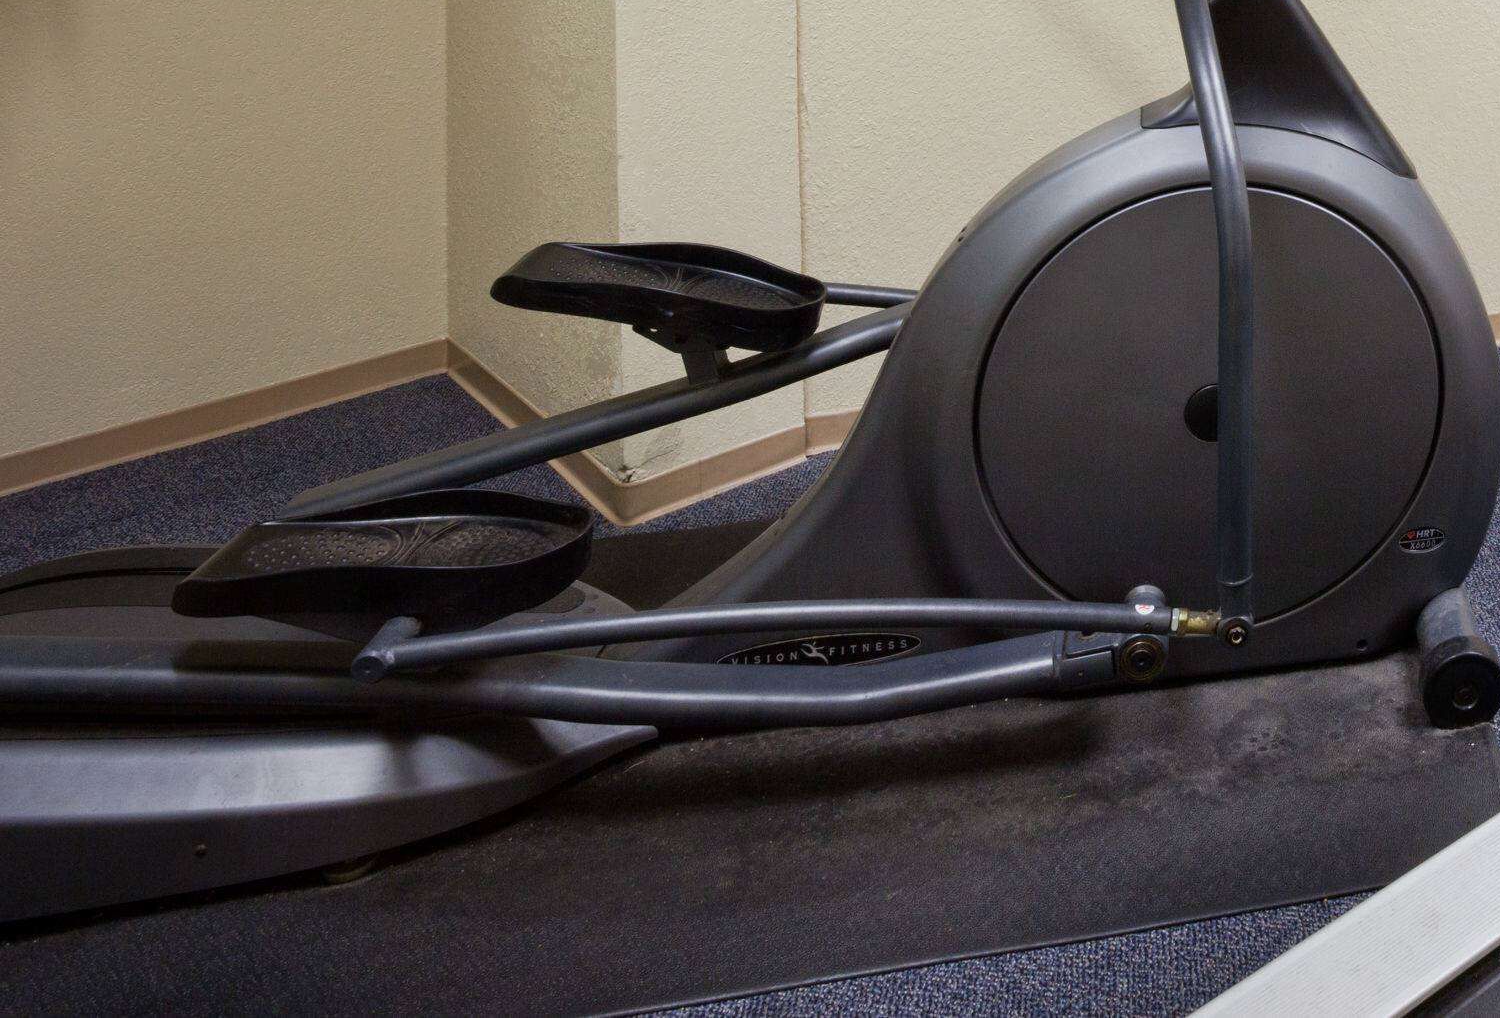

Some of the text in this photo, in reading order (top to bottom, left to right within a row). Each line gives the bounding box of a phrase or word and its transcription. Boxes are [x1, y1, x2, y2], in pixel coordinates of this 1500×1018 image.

[1416, 529, 1436, 539] HRT
[731, 639, 908, 665] VISION FITNESS
